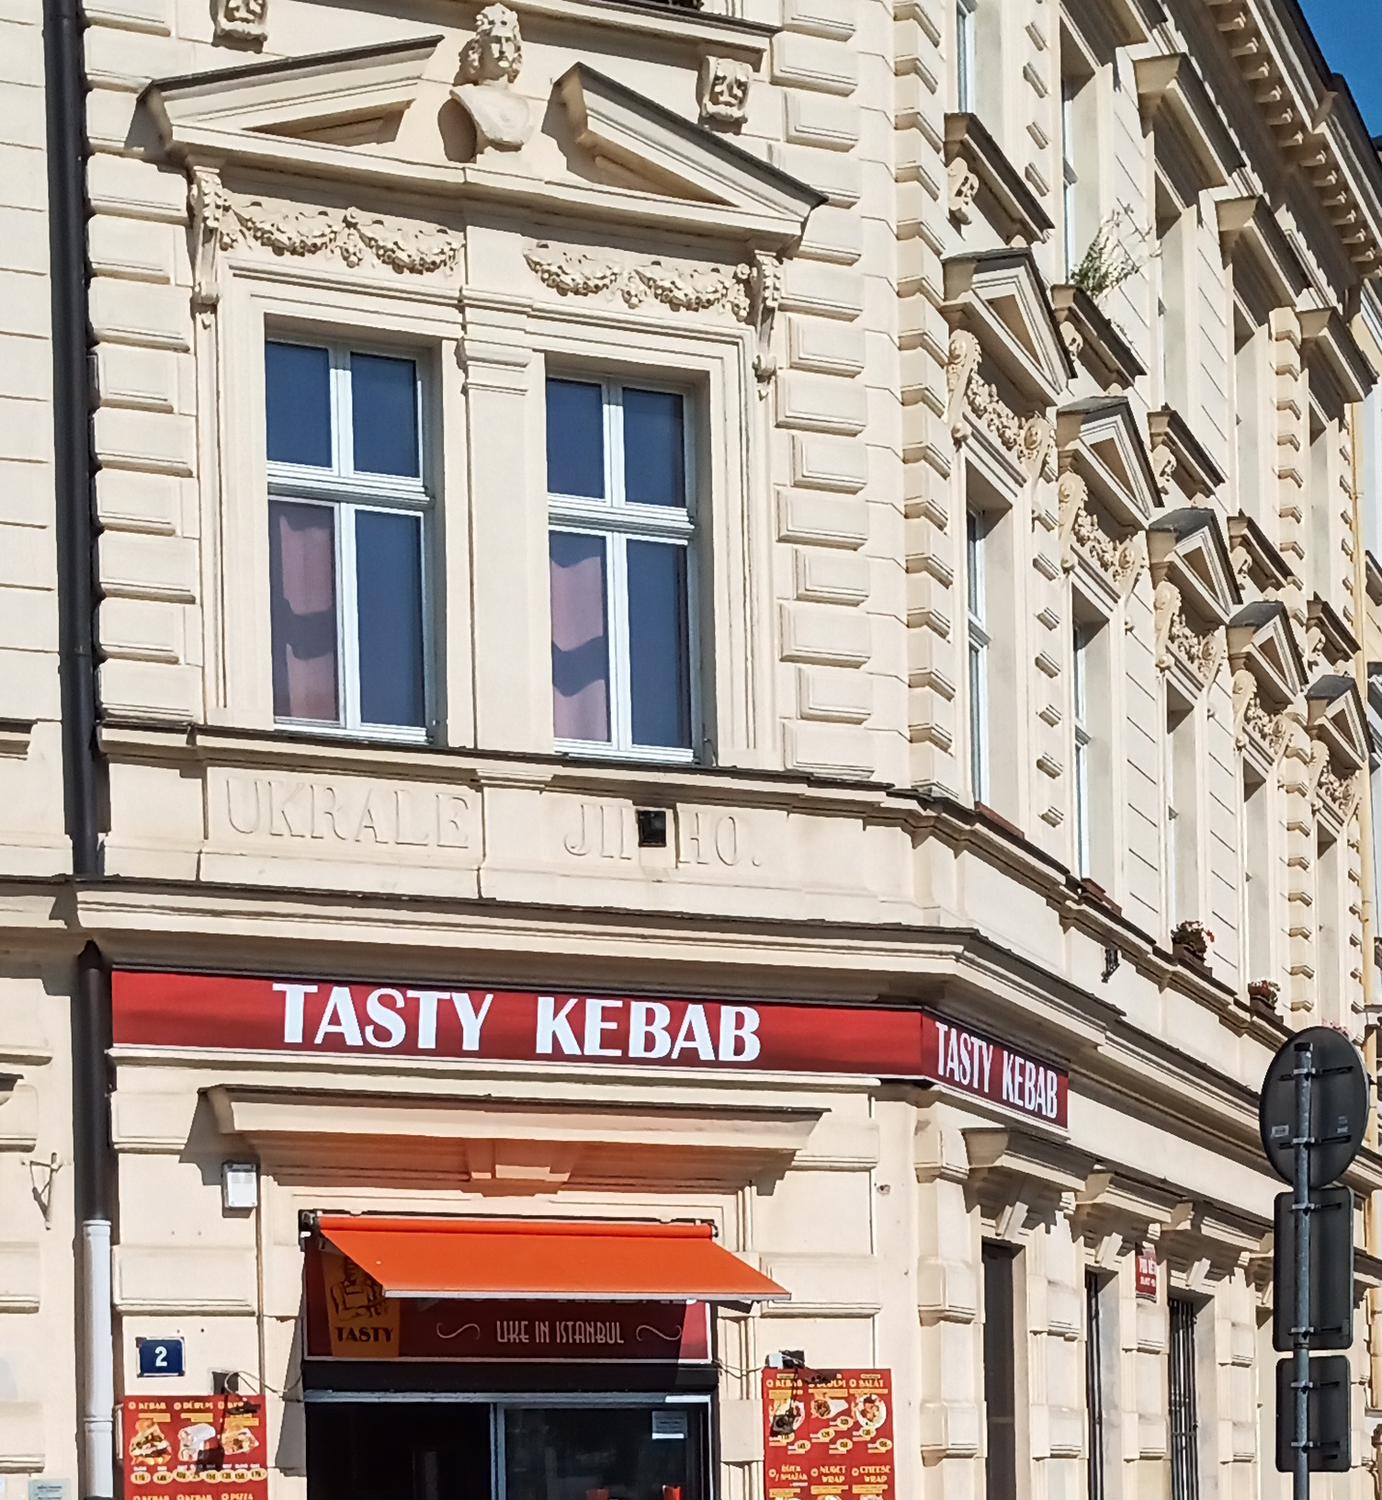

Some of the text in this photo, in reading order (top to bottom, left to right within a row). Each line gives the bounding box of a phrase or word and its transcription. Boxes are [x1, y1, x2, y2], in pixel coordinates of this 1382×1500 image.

[272, 982, 761, 1062] TASTY KEBAB
[935, 1021, 1058, 1119] TASTY KEBAB
[335, 1326, 394, 1344] TASTY
[496, 1320, 625, 1345] LIKE IN ISTANBUL
[154, 1345, 168, 1367] 2
